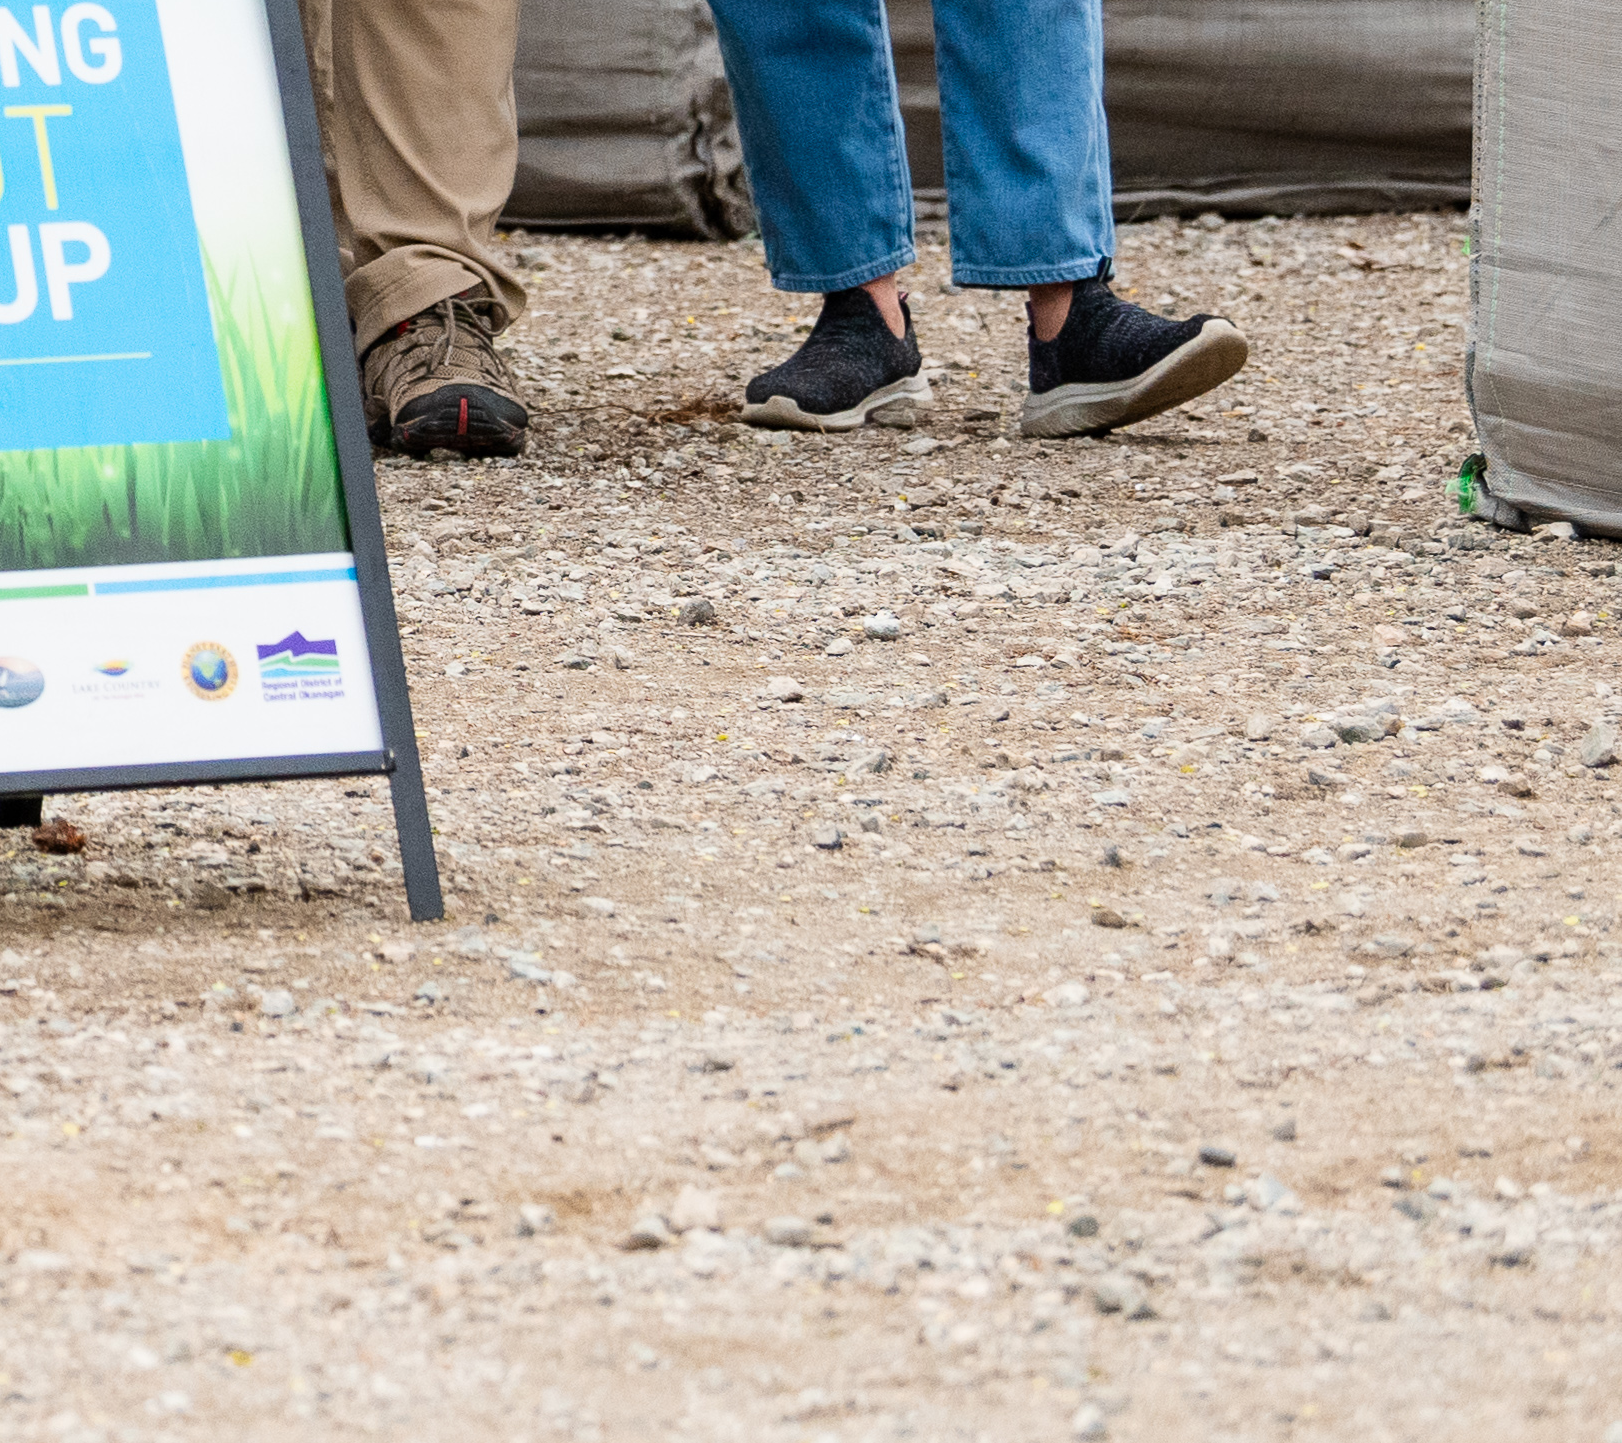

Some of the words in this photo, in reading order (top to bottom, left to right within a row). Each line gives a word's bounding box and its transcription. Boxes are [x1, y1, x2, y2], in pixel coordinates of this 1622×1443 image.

[260, 680, 298, 691] Regional
[301, 677, 330, 689] District
[263, 691, 297, 702] Central
[299, 688, 345, 700] Okanagan
